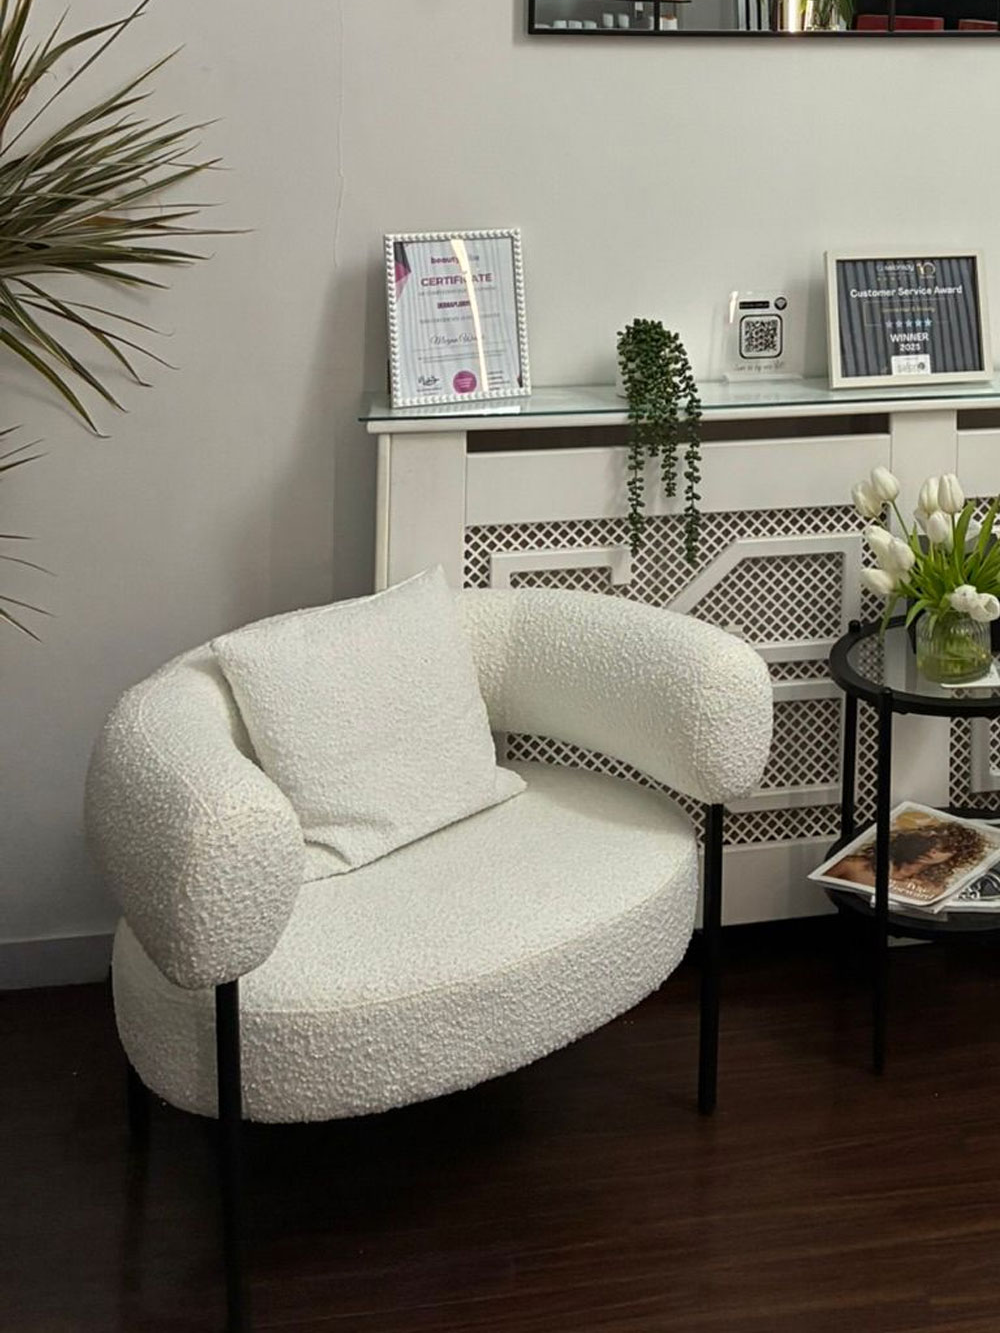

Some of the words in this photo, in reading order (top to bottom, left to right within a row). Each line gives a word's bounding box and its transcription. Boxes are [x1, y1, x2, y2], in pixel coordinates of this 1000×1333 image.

[420, 273, 493, 287] CERTIFIATE
[850, 289, 896, 298] Customer
[898, 286, 932, 297] Service
[933, 284, 963, 295] Award
[889, 332, 929, 343] WINNER
